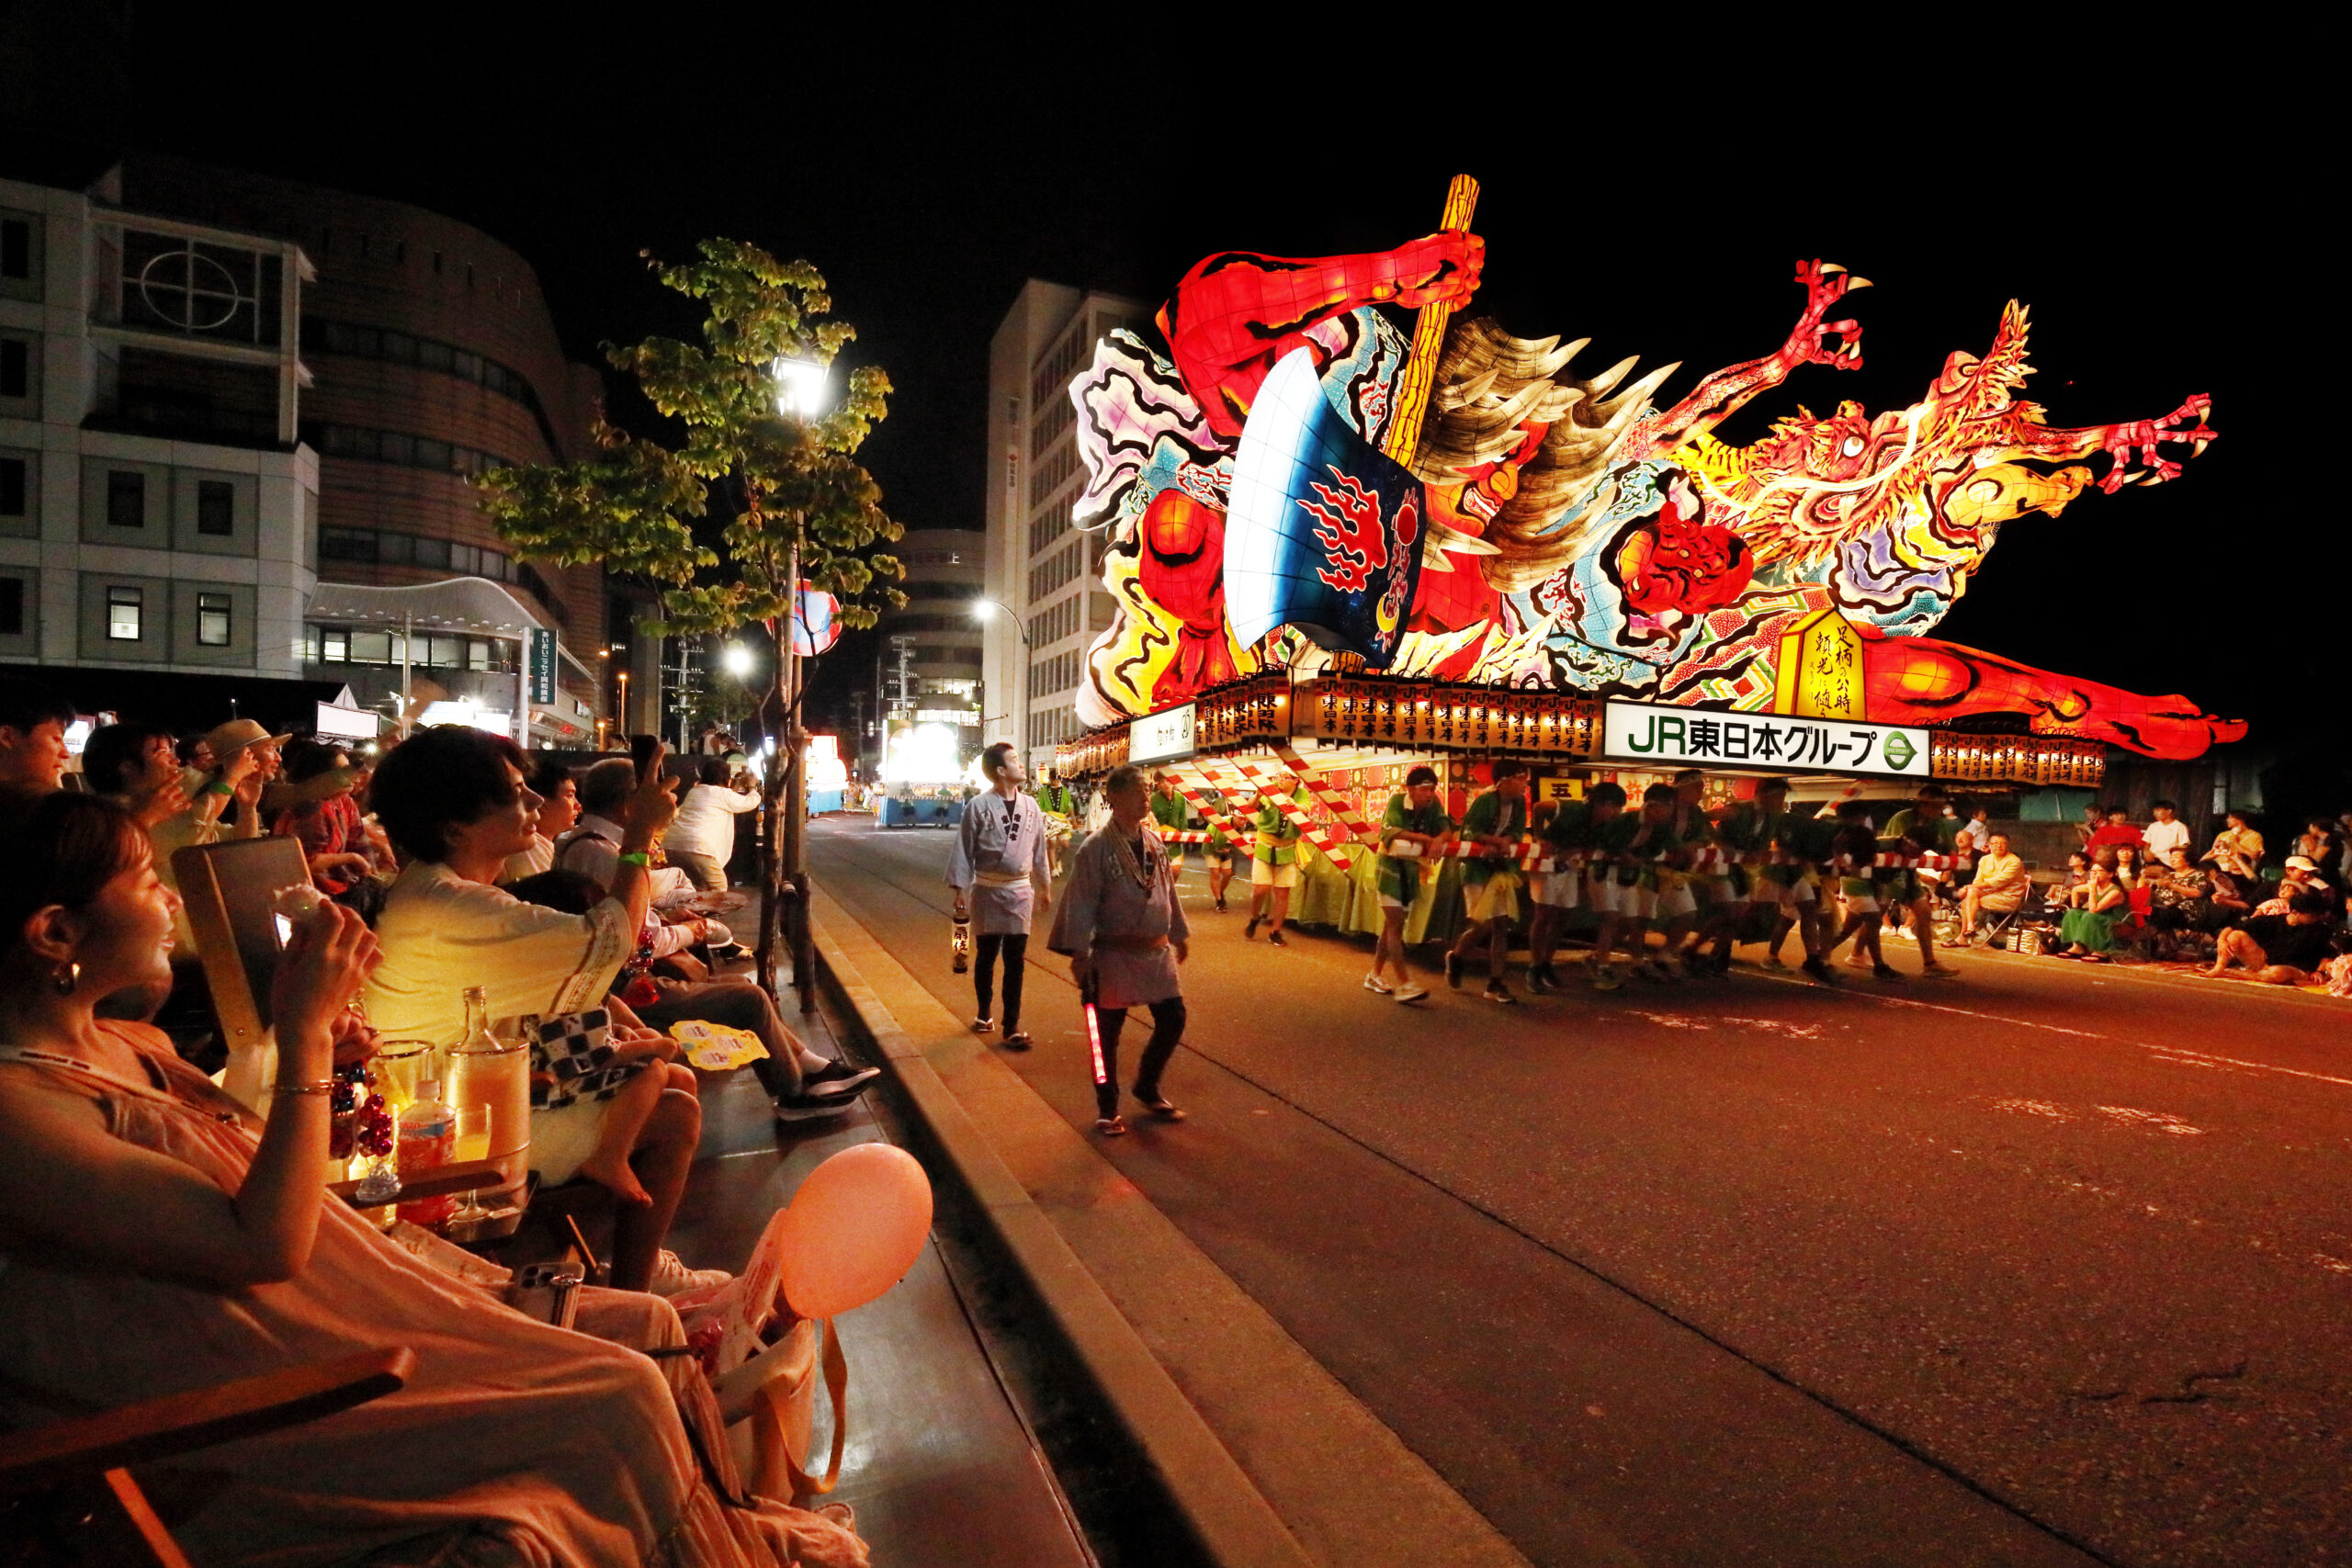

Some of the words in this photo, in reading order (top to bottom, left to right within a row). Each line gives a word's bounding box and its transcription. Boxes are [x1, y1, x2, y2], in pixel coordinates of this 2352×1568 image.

[1628, 715, 1878, 767] JR東日本グループ
